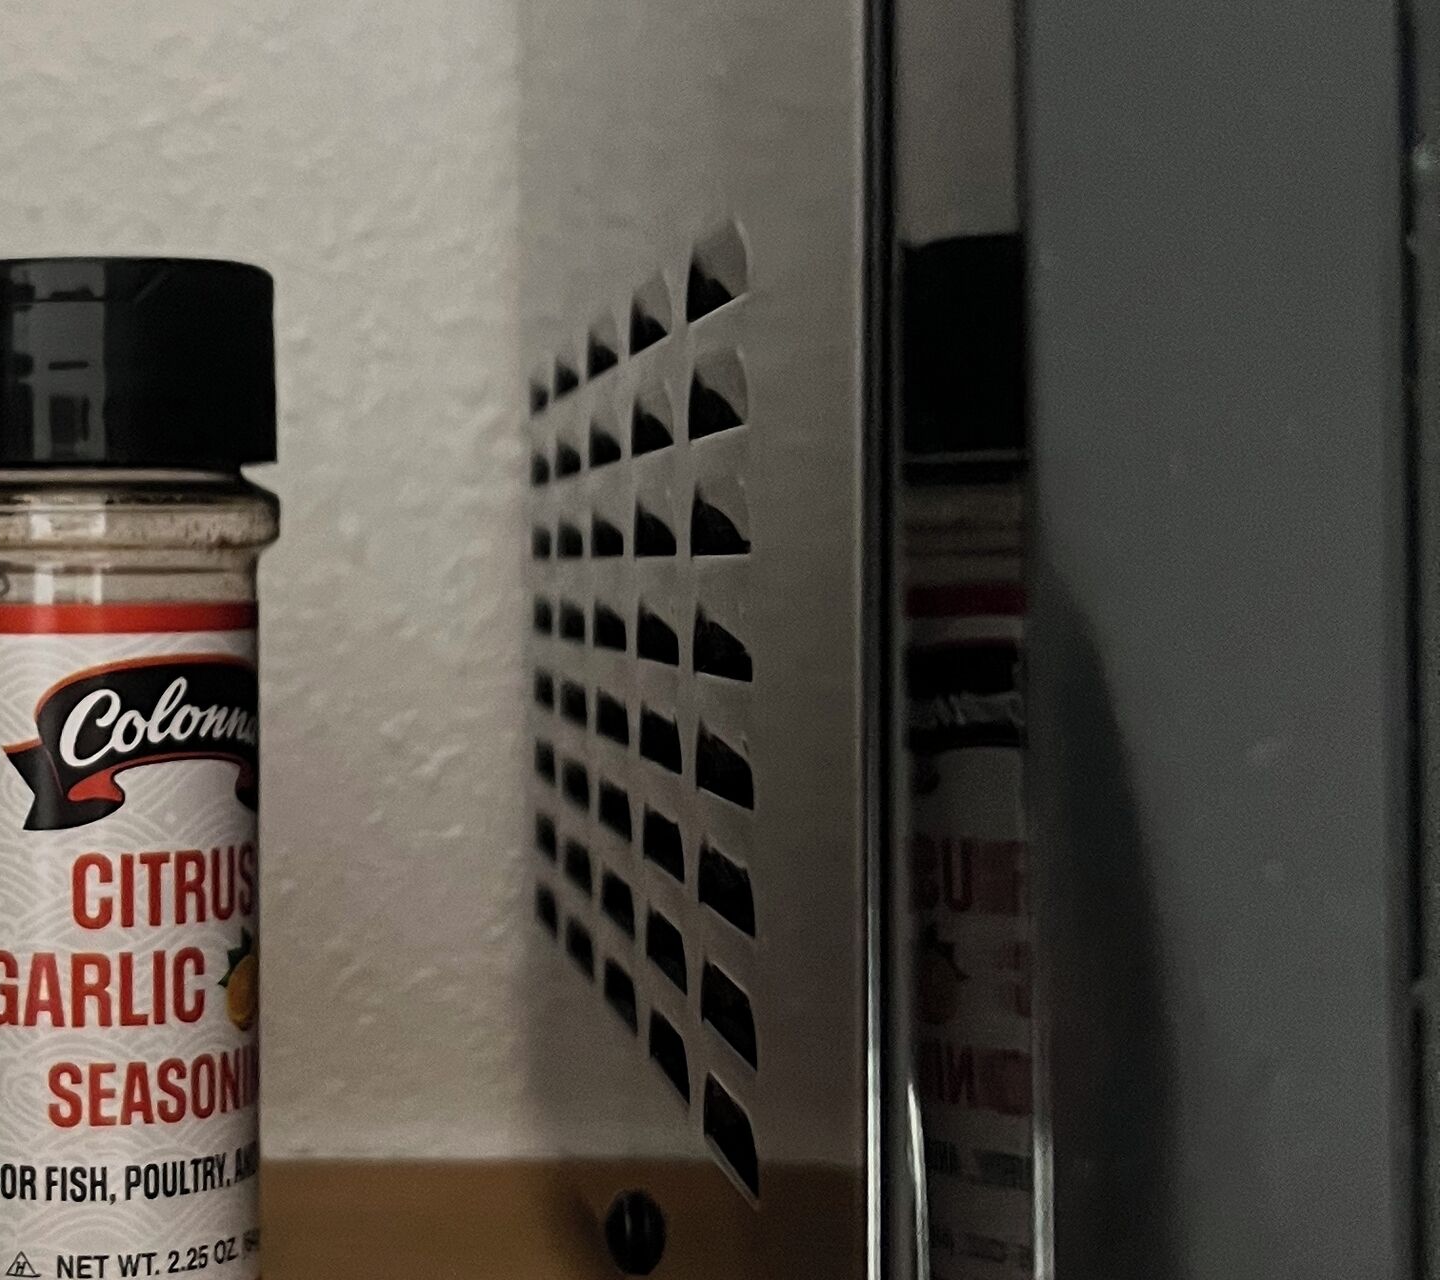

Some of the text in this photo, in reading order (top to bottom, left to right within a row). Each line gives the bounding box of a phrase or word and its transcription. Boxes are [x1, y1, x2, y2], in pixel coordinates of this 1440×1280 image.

[71, 841, 256, 930] CITRUS
[45, 1166, 117, 1205] FISH,
[56, 1255, 109, 1279] NET
[117, 1252, 160, 1278] WT.
[167, 1244, 209, 1274] 2.25
[213, 1237, 238, 1264] OZ
